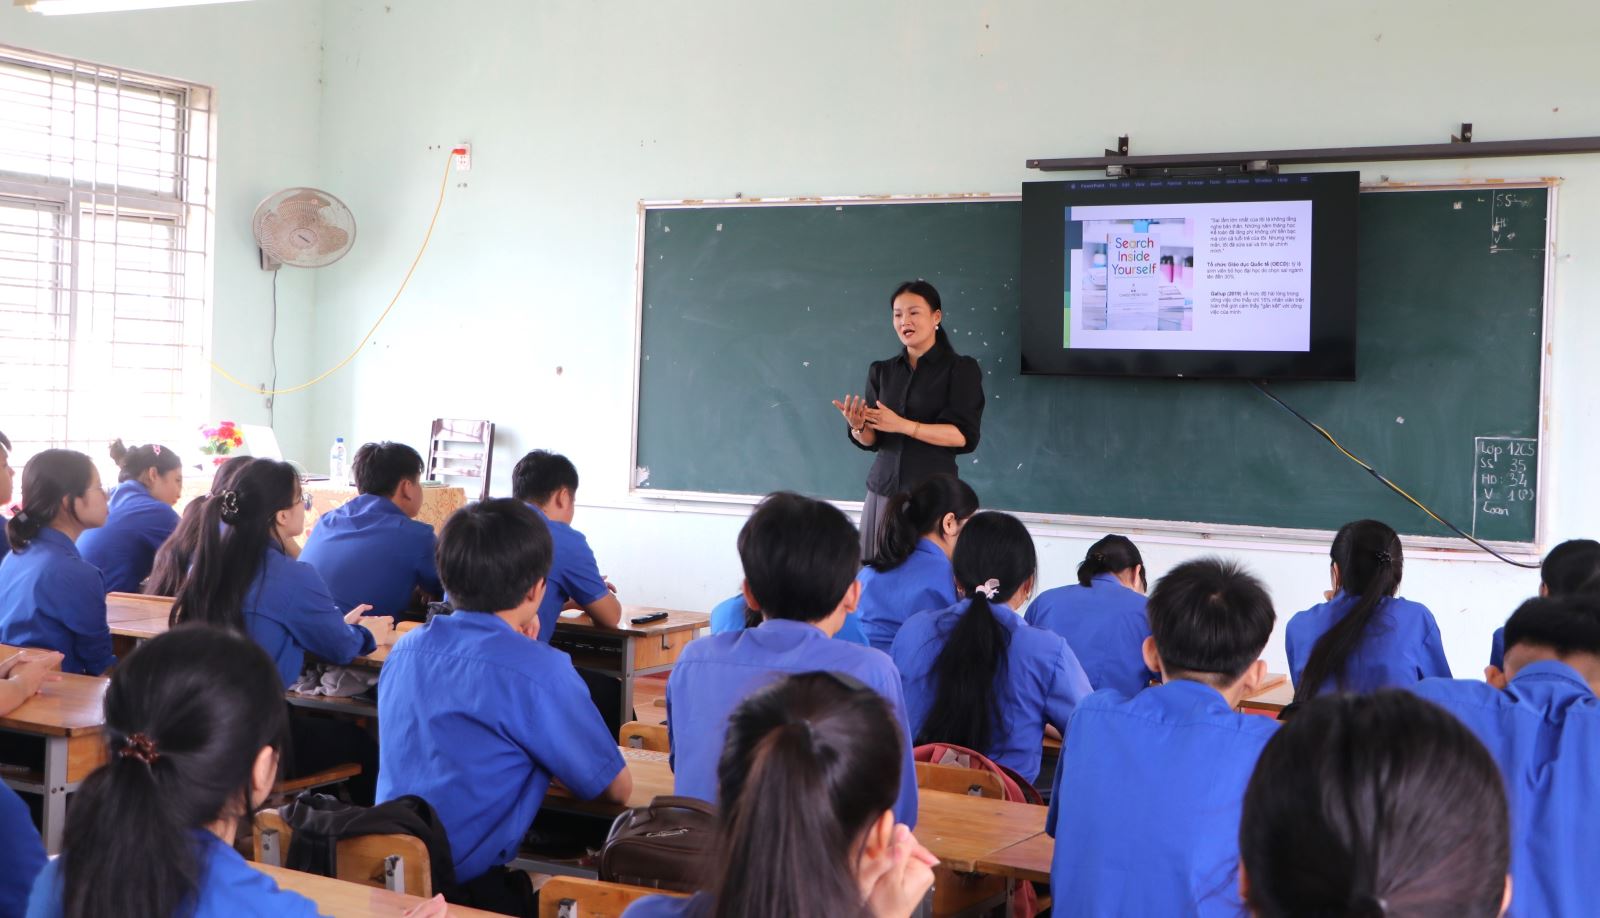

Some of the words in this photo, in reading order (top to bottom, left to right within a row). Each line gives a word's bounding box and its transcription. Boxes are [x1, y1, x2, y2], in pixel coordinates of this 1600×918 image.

[1115, 237, 1154, 249] Search
[1118, 250, 1150, 262] Inside
[1111, 263, 1157, 275] Yourself
[1507, 441, 1535, 457] 12C5
[1510, 458, 1527, 474] 35
[1509, 473, 1527, 487] 34
